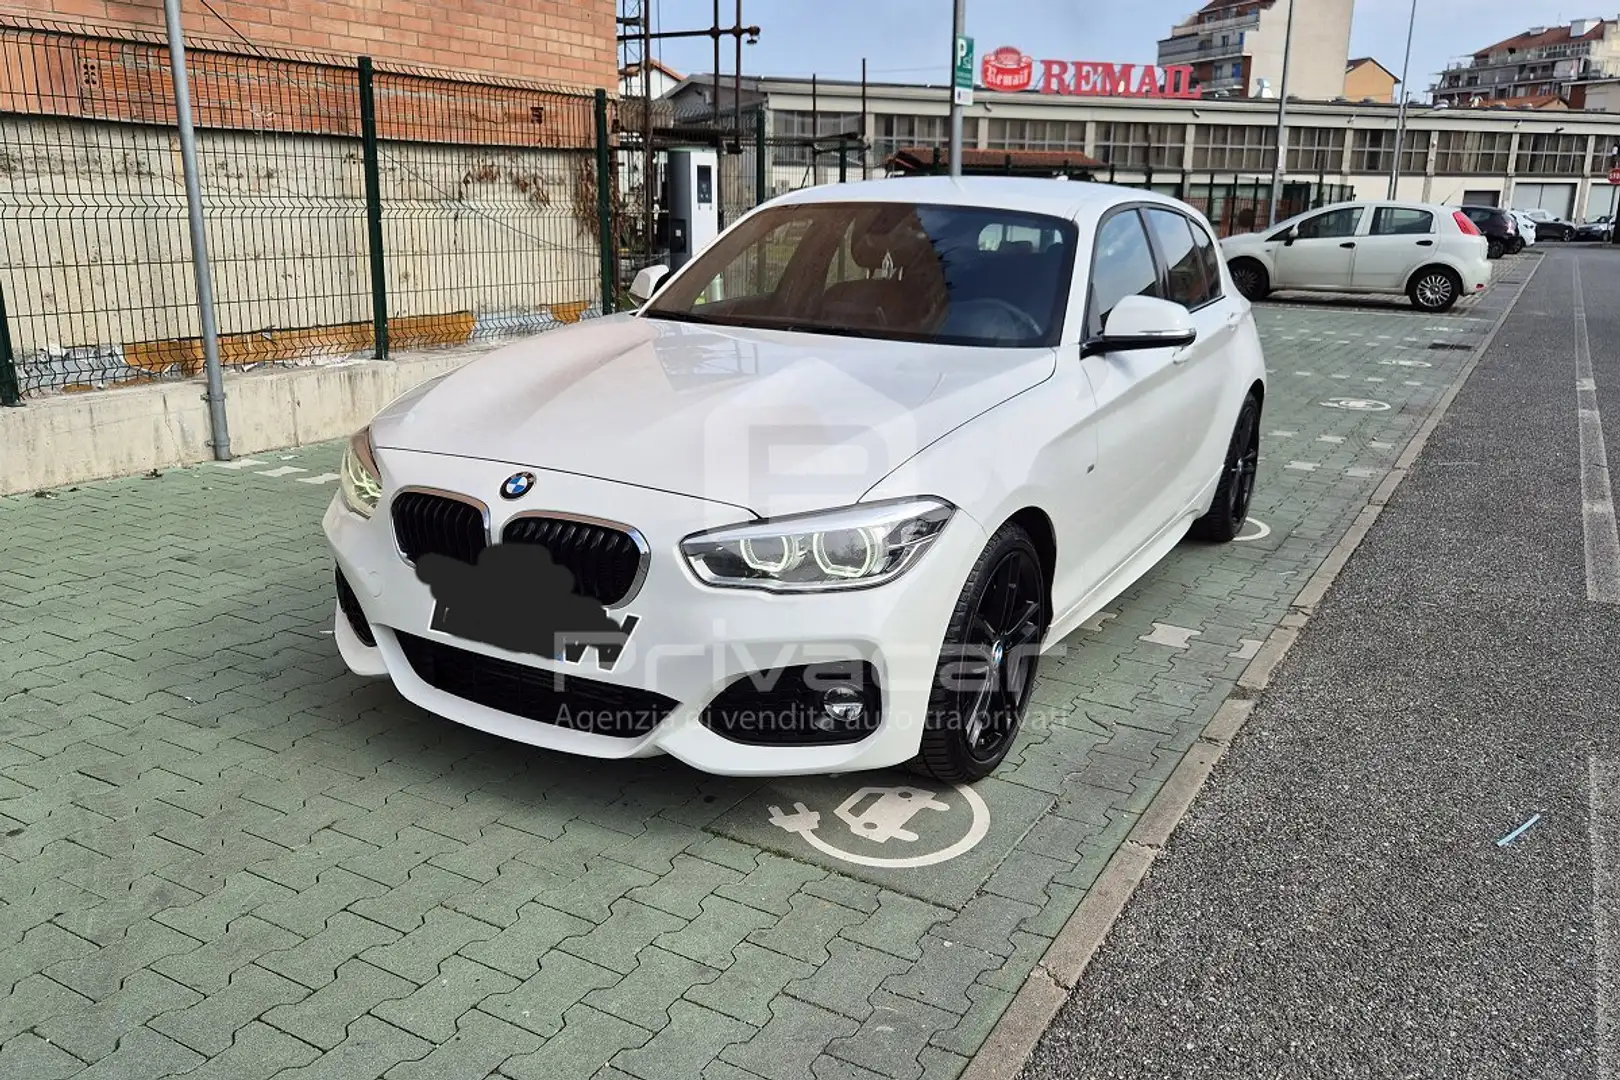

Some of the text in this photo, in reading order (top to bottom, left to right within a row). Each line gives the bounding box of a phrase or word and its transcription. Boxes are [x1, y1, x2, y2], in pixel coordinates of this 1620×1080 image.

[957, 38, 968, 67] P
[985, 65, 1030, 86] Remail
[1039, 60, 1203, 98] REMAIL
